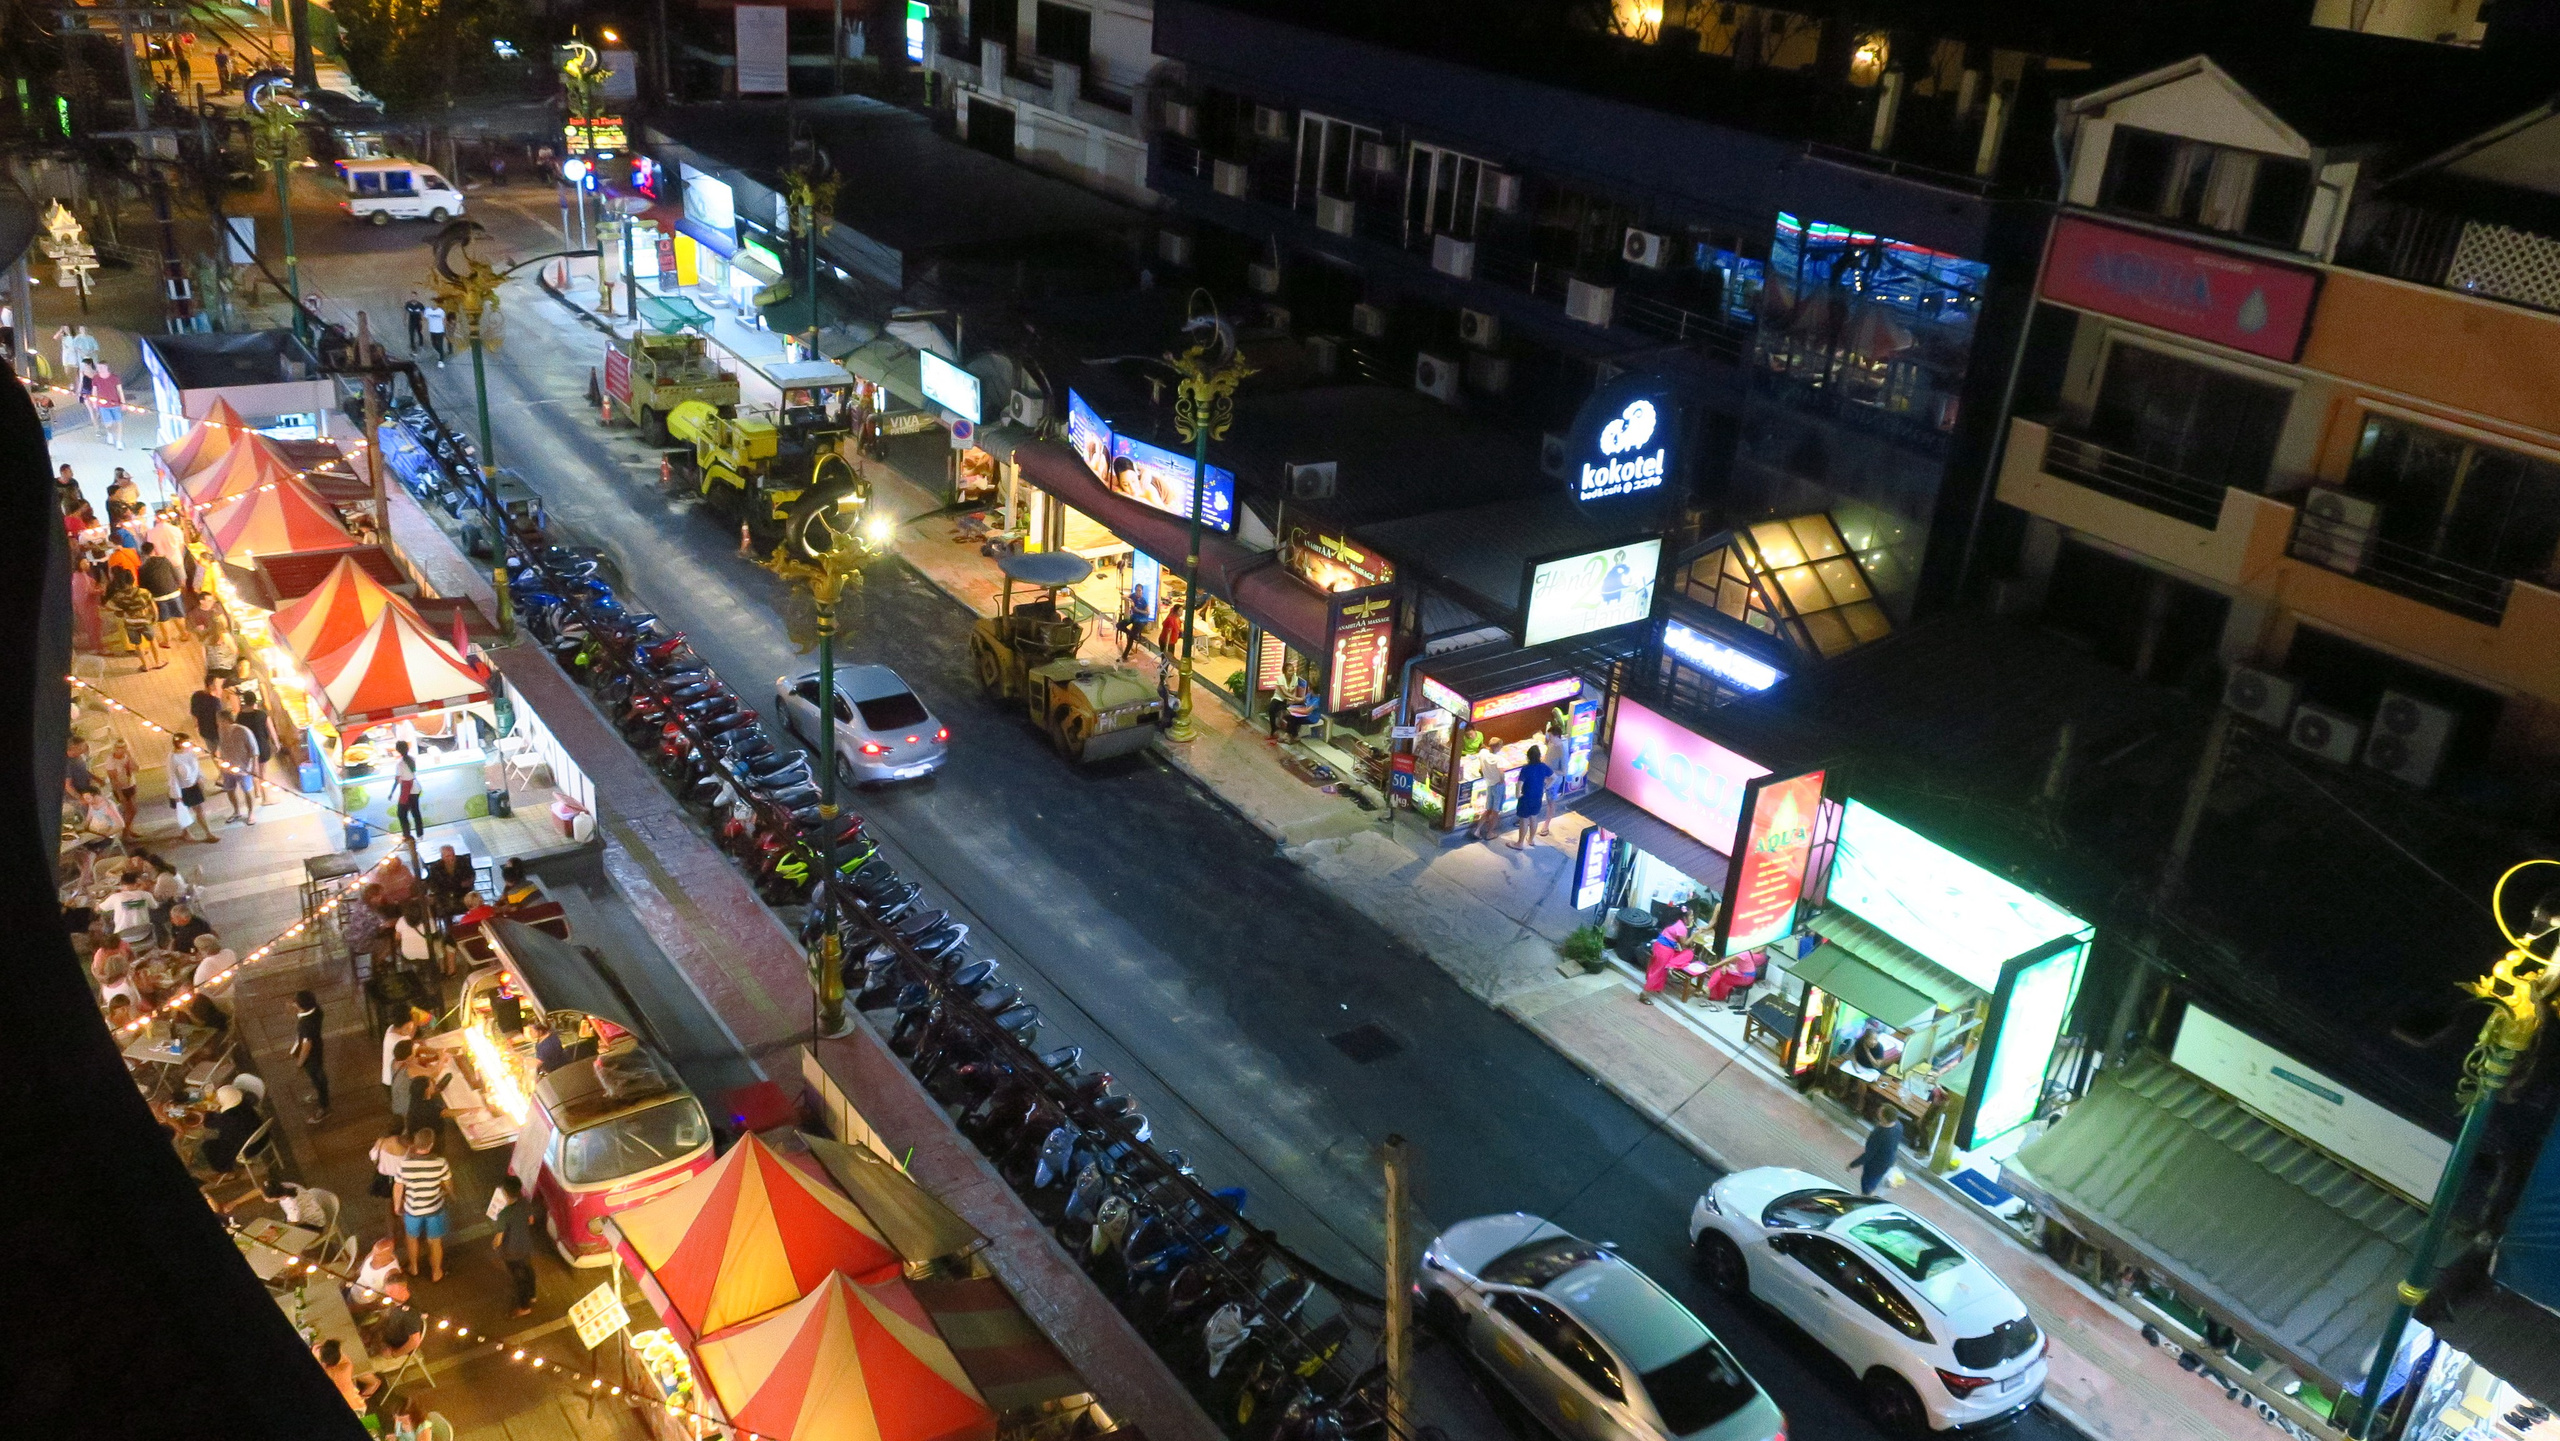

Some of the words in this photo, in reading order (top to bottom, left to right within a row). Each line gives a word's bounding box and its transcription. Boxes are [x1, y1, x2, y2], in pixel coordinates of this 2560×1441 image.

[890, 415, 919, 428] VIVA
[890, 427, 920, 436] PATONG
[1581, 448, 1665, 491] kokotel
[1349, 562, 1376, 582] MASSAGE
[1367, 616, 1391, 626] MASSAGE
[1581, 598, 1638, 633] Hand
[1752, 825, 1807, 855] AQUA
